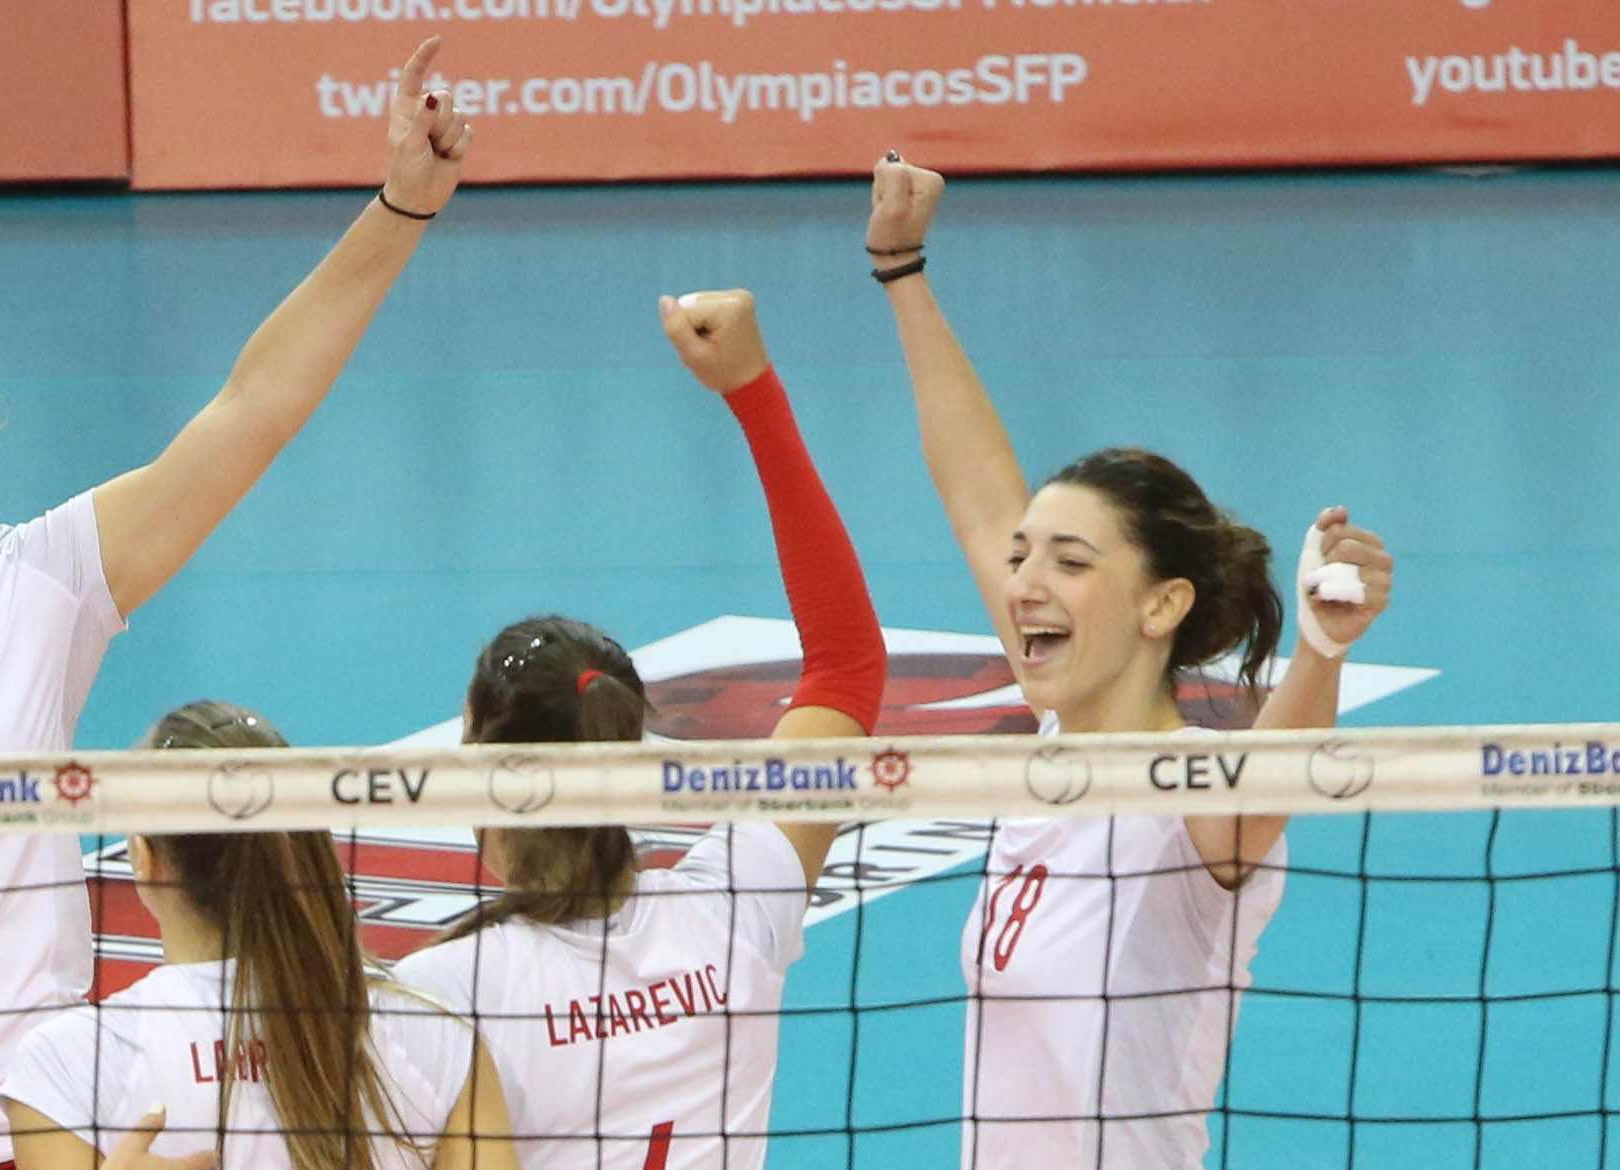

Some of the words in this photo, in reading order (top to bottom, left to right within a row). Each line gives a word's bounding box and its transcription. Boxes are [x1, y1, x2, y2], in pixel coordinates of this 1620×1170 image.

[316, 54, 1088, 124] twiter.com/OlympiacosSFP
[332, 768, 428, 804] CEV
[662, 757, 857, 793] DenizBank
[1150, 753, 1247, 790] CEV
[976, 863, 1048, 972] 18
[545, 963, 728, 1047] LAZAREVIC
